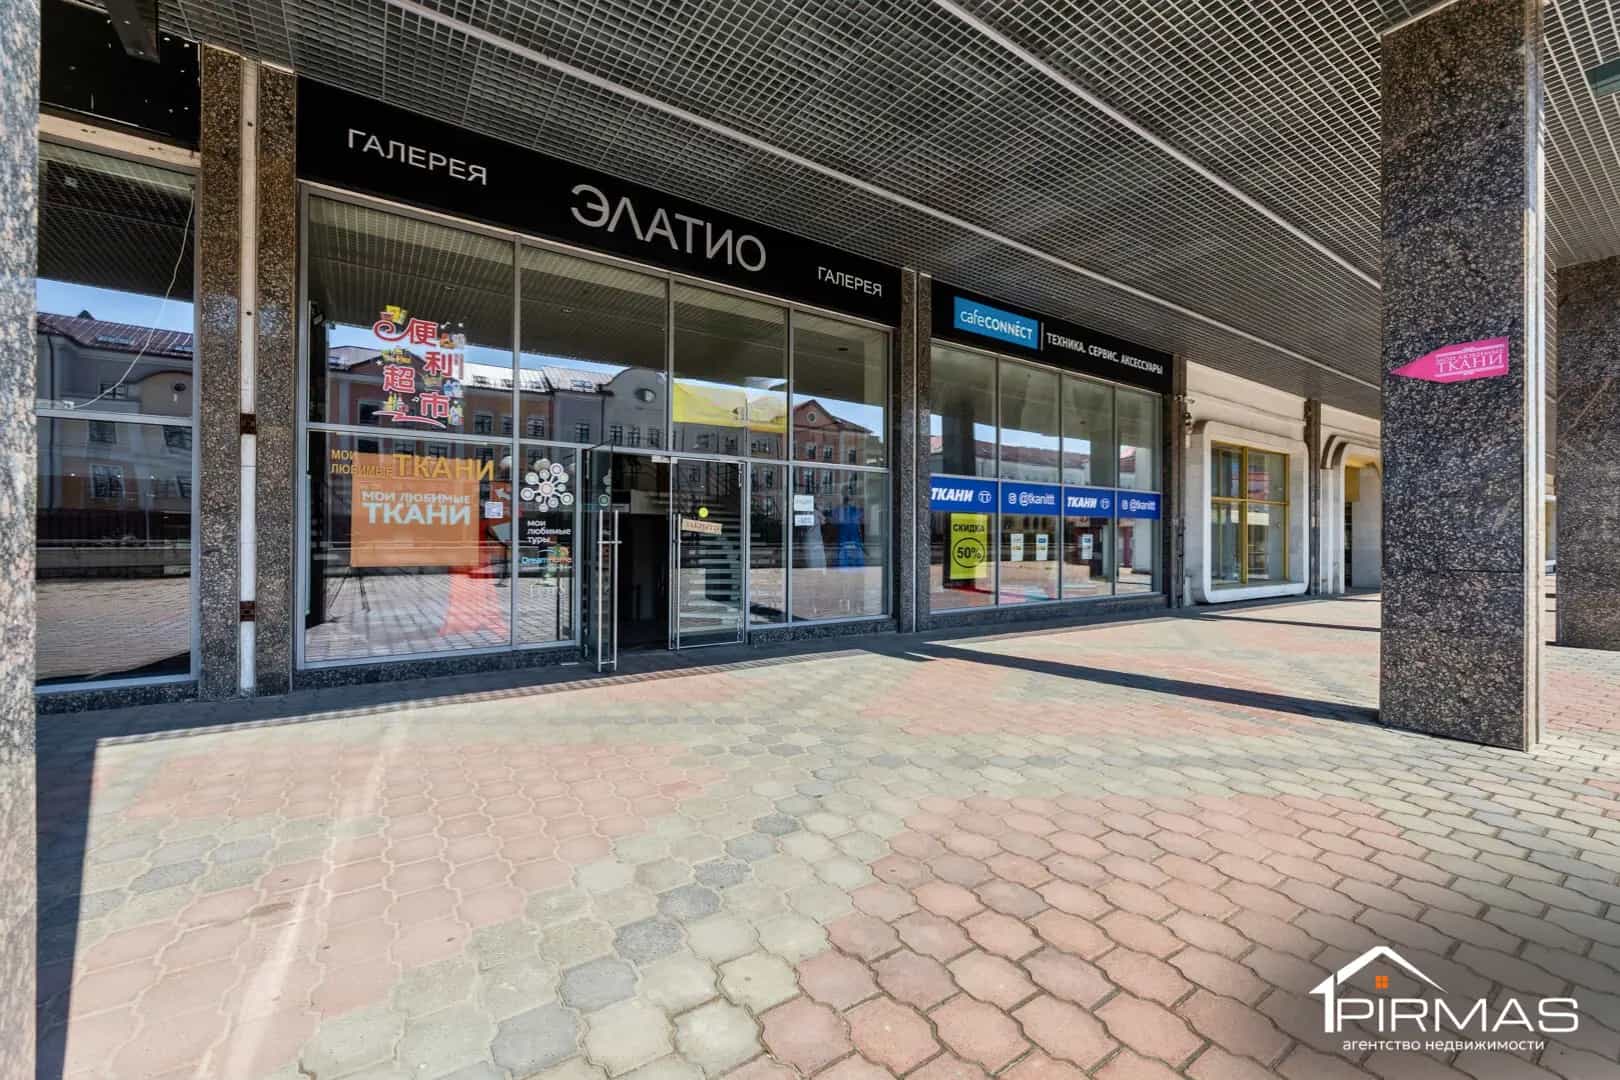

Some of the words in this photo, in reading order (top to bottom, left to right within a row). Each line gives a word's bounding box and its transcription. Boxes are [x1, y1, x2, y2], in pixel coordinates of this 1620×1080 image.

[348, 128, 487, 186] ГАЛЕРЕЯ
[570, 184, 767, 272] ЭЛАТИО
[818, 266, 883, 297] ГАЛЕРЕЯ
[1120, 353, 1163, 376] АКСЕССУАРЫ
[1437, 353, 1503, 373] ТКАНИ
[393, 453, 495, 481] ТКАНИ
[361, 490, 395, 503] МОИ
[931, 487, 974, 502] ТКАНИ
[1066, 496, 1098, 509] ТКАНИ
[363, 502, 471, 526] ТКАНИ
[952, 523, 985, 533] СКИДКА
[957, 546, 982, 559] 50%
